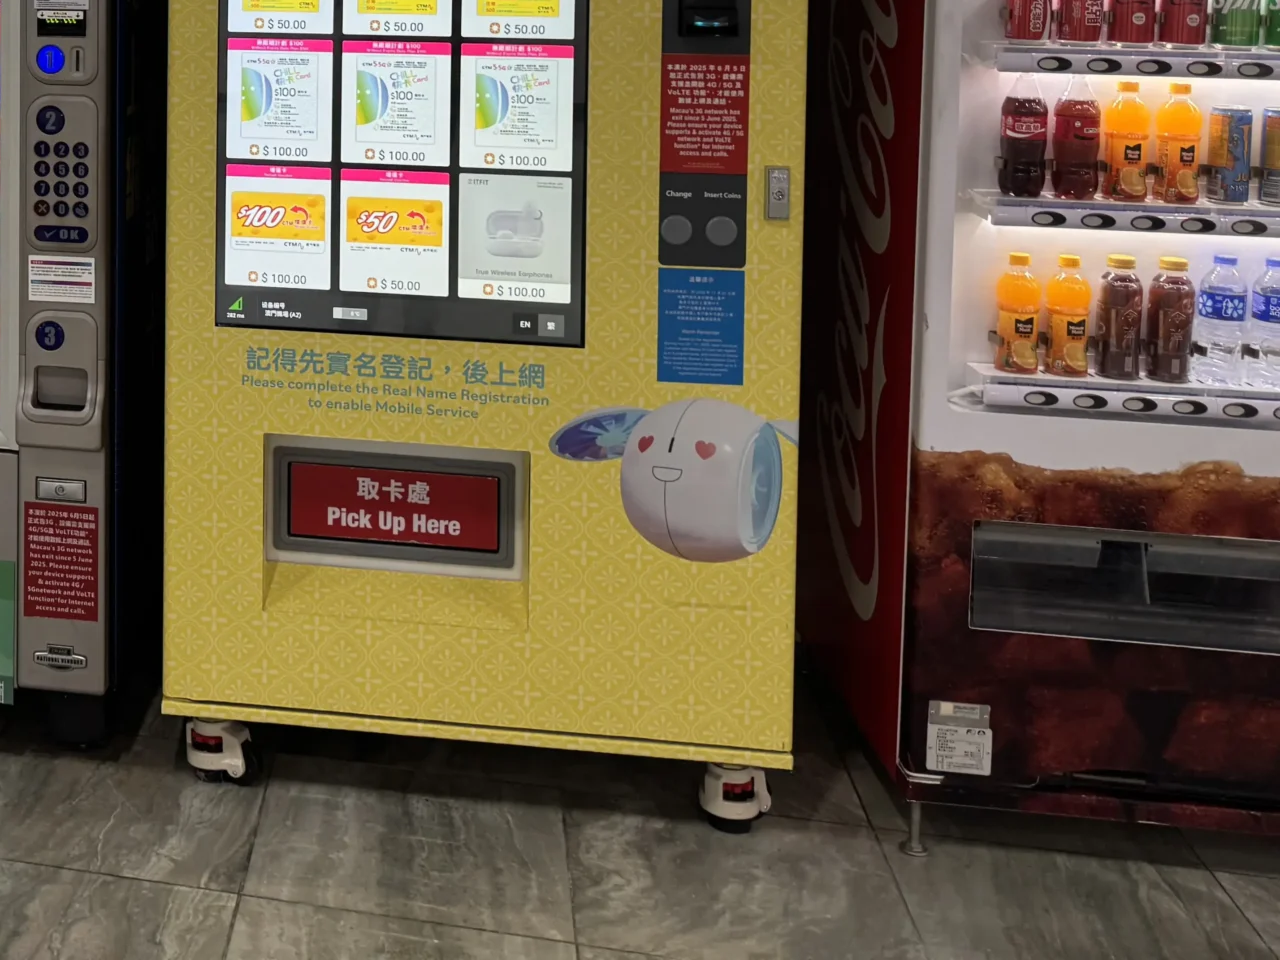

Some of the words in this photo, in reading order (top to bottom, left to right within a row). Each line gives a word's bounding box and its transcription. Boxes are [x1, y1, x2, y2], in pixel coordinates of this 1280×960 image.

[277, 19, 306, 29] 50.00
[393, 21, 424, 32] 50.00
[514, 24, 545, 35] 50.00
[45, 111, 57, 130] 2
[273, 146, 308, 157] 100.00
[389, 150, 425, 162] 100.00
[509, 155, 547, 166] 100.00
[665, 190, 692, 199] Change
[237, 204, 287, 229] $100
[356, 210, 400, 234] $50
[59, 228, 79, 240] OK
[271, 273, 307, 285] 100.00
[390, 279, 421, 291] 50.00
[507, 286, 546, 298] 100.00
[44, 326, 56, 346] 3
[241, 375, 284, 389] Please
[288, 378, 352, 393] complete
[355, 382, 379, 395] the
[382, 384, 412, 397] Real
[416, 386, 456, 399] Name
[460, 388, 550, 407] Registration
[307, 397, 322, 409] to
[325, 399, 372, 412] enable
[375, 401, 423, 415] Mobile
[426, 404, 479, 419] Service
[356, 476, 430, 505] 取卡處
[327, 506, 372, 529] Pick
[378, 511, 406, 534] Up
[412, 513, 461, 536] Here
